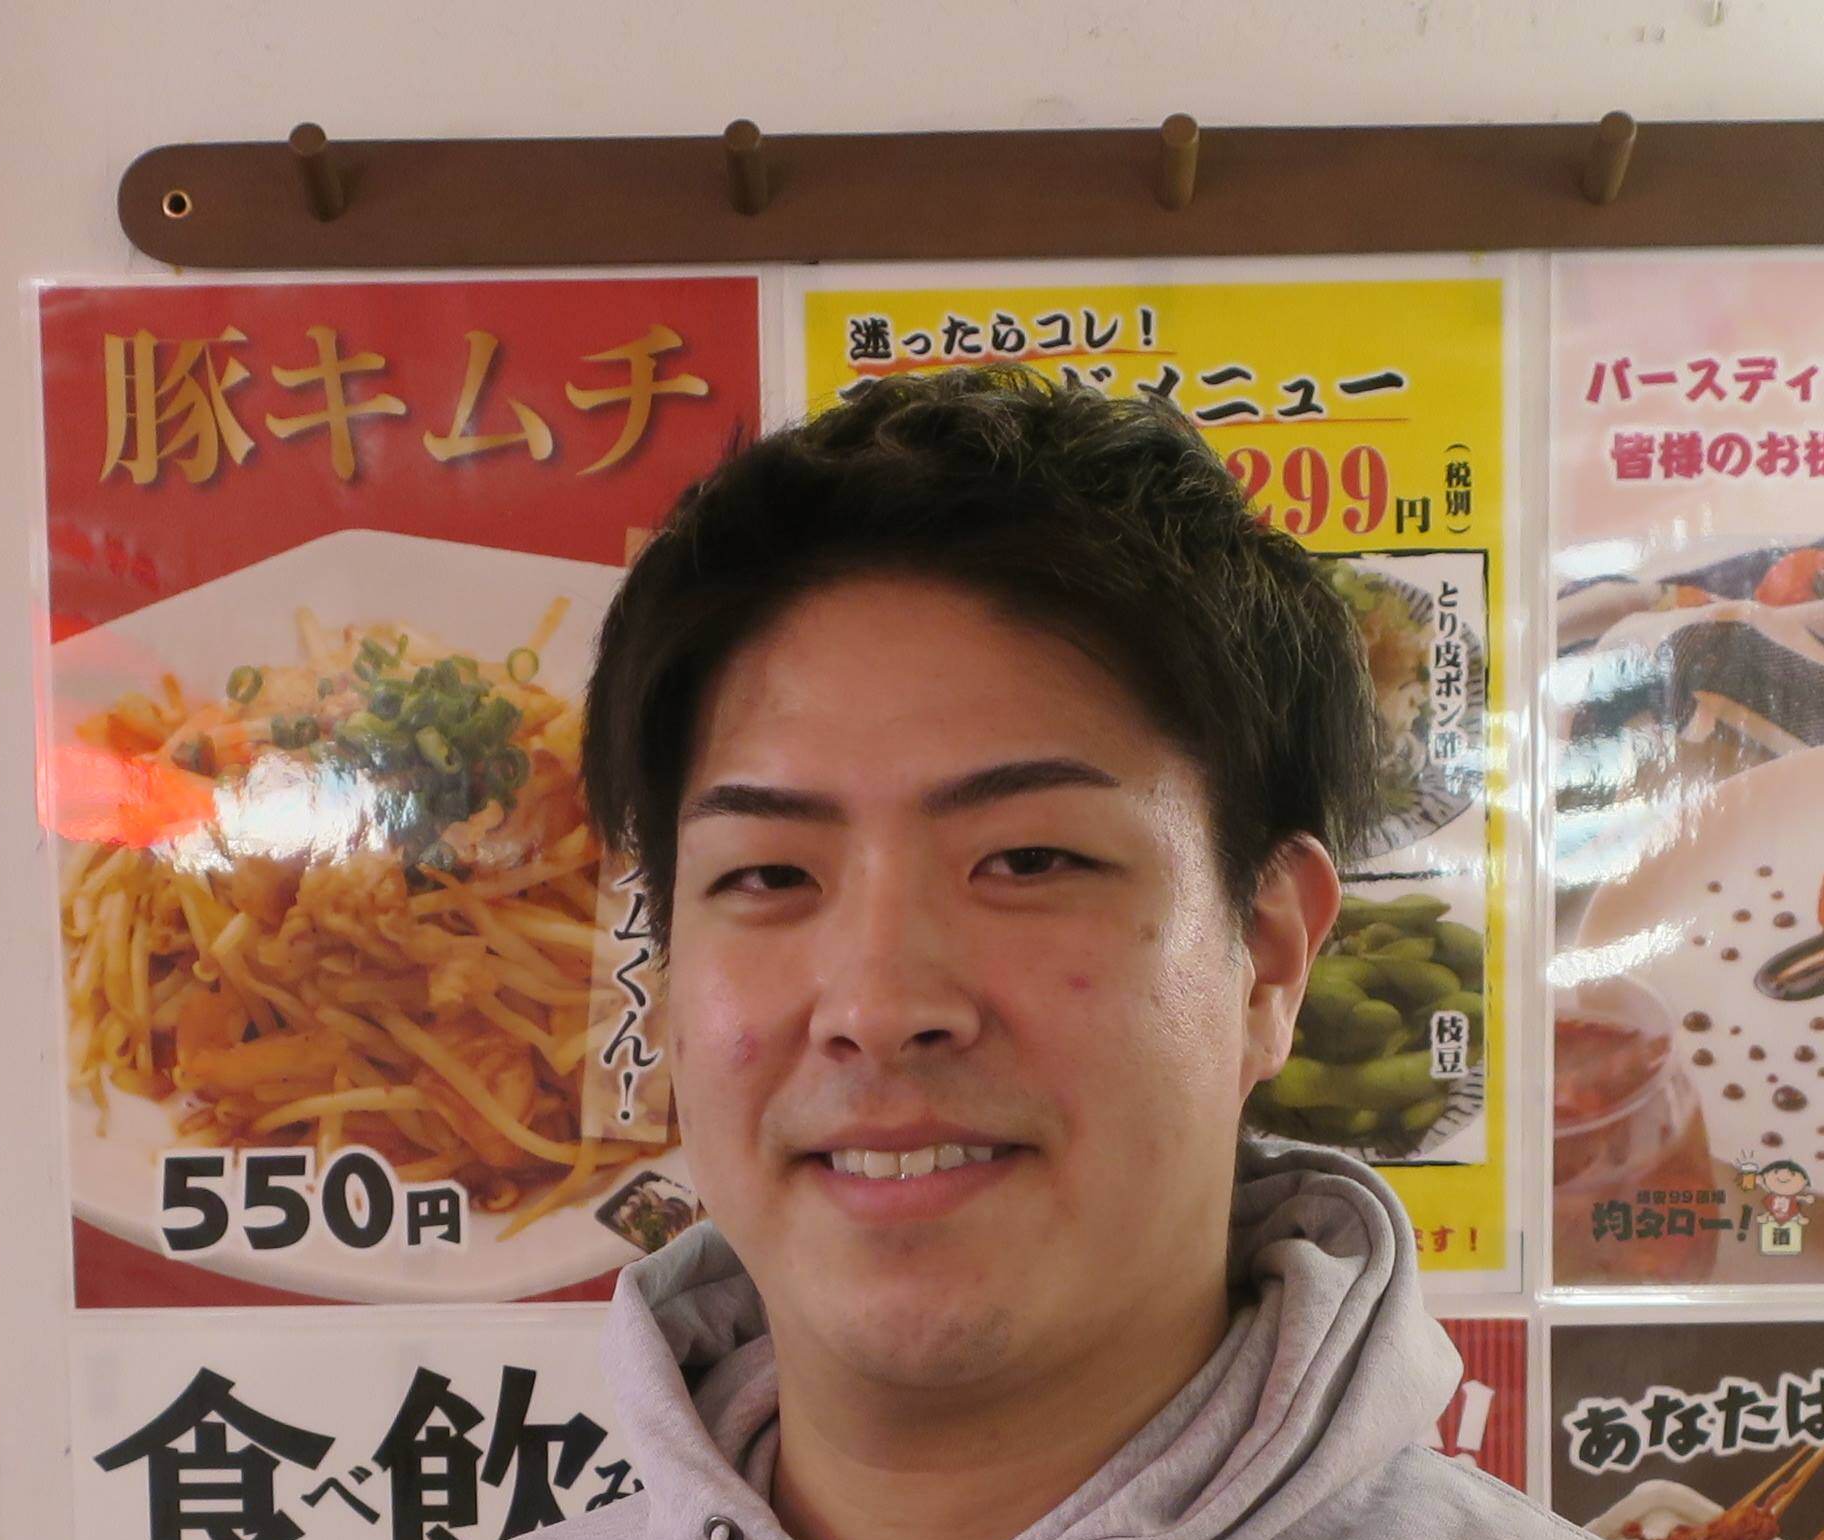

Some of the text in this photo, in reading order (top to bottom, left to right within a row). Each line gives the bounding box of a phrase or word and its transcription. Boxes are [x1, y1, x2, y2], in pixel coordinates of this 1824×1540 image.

[849, 309, 1155, 362] 迷ったらコレ！
[99, 323, 709, 485] 豚キムチ
[1434, 580, 1463, 759] とり皮ポン酢
[1434, 1014, 1466, 1076] 枝豆
[161, 1152, 463, 1251] 550円
